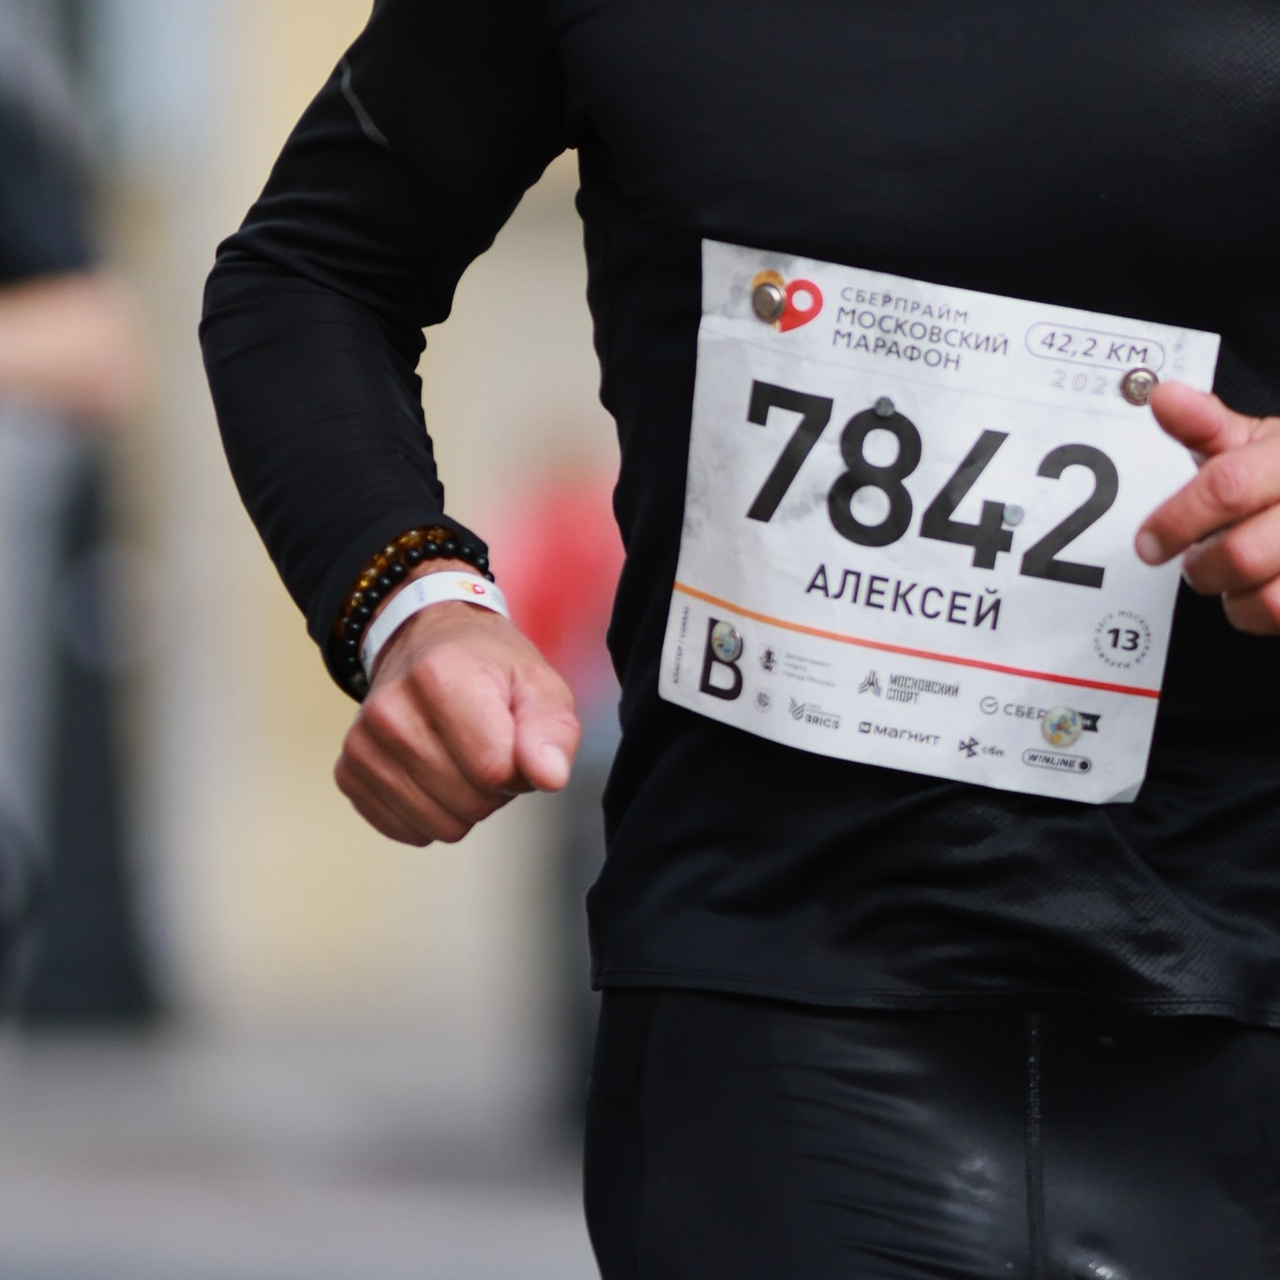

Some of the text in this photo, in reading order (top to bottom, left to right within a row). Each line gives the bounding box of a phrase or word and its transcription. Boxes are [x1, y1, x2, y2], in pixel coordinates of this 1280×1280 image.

[840, 286, 969, 324] СБЕРПРАЙМ
[836, 306, 1009, 355] МОСКОВСКИЙ
[1041, 332, 1097, 358] 42,2
[832, 329, 961, 371] МАРАФОН
[1051, 369, 1123, 398] 202
[746, 379, 1119, 589] 7842
[804, 563, 1002, 631] АЛЕКСЕЙ
[1107, 628, 1140, 651] 13
[886, 687, 920, 705] СПОРТ
[887, 673, 960, 698] МОСКОВСКИЙ
[804, 714, 840, 730] BRICS
